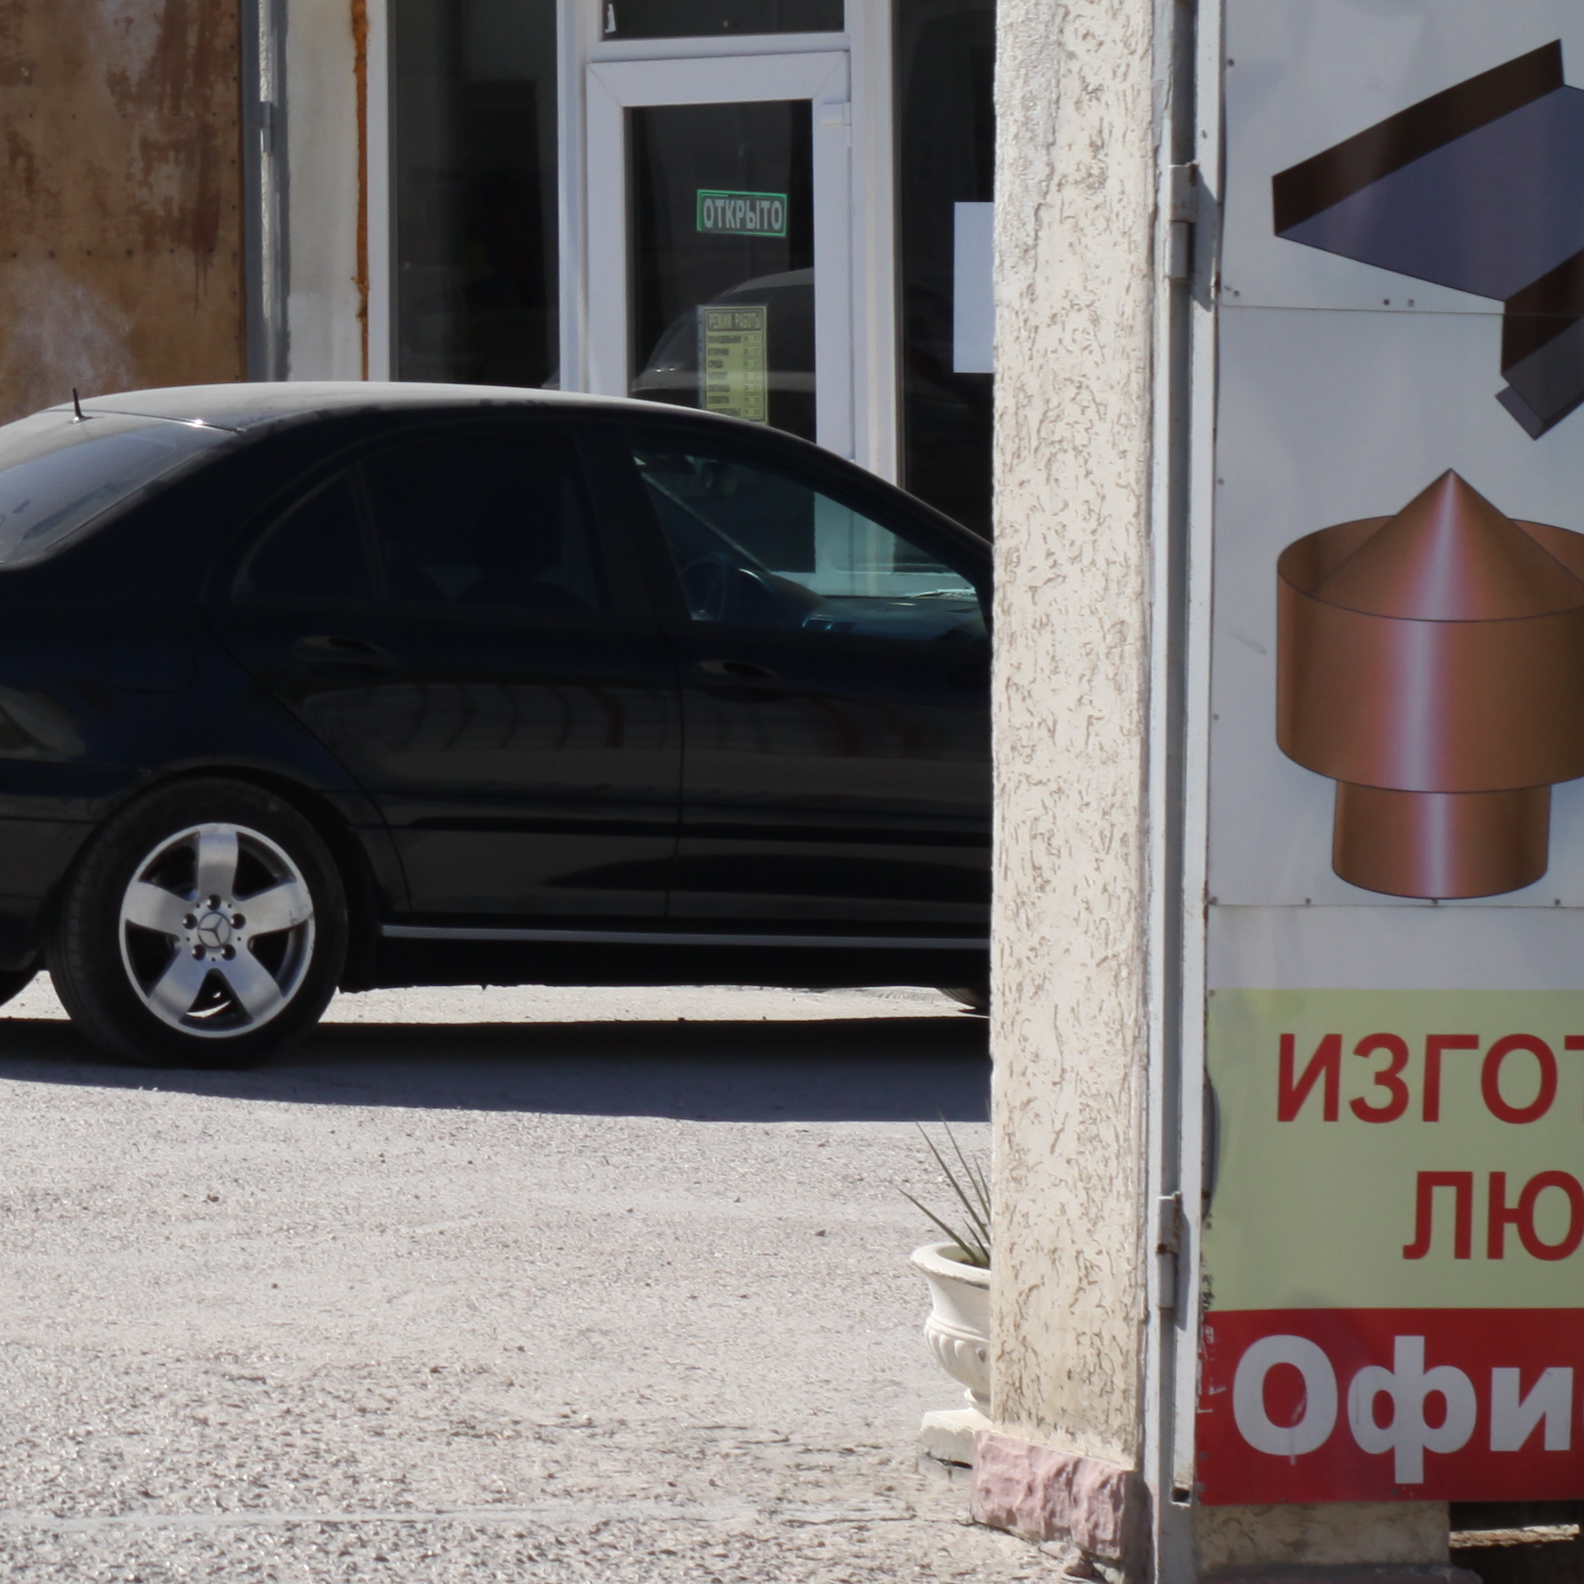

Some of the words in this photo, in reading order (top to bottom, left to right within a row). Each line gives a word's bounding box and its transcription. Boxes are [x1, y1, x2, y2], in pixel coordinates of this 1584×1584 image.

[703, 198, 783, 231] ОТКРЫТО
[1277, 1032, 1584, 1125] ИЗГО
[1402, 1169, 1584, 1262] ЛЮ
[1232, 1333, 1574, 1485] Офи
